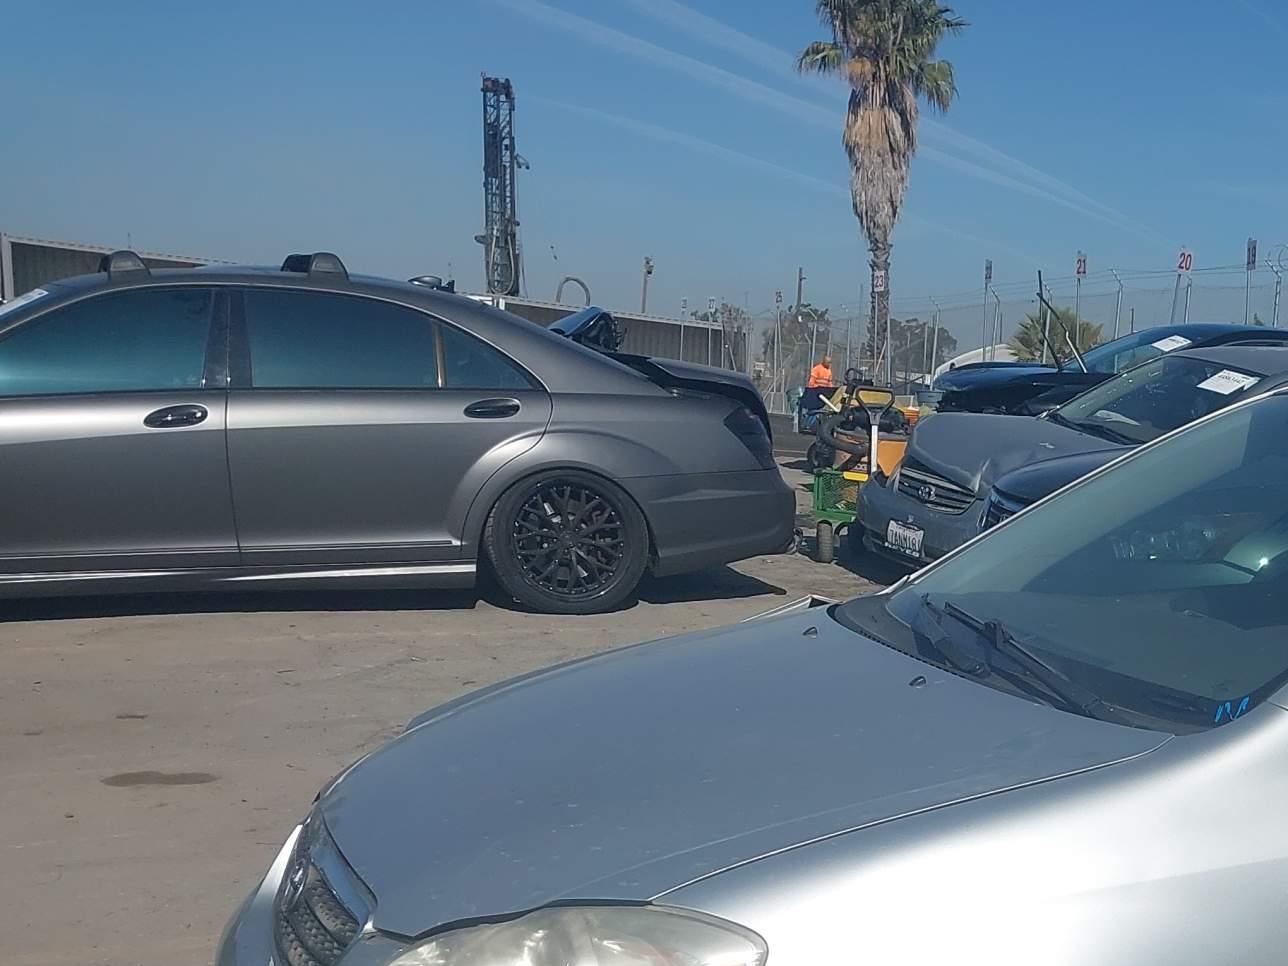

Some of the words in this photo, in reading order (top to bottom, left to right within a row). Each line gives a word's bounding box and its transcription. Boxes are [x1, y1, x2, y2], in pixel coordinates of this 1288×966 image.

[1178, 252, 1192, 271] 20
[1246, 247, 1257, 265] 19
[1076, 259, 1087, 275] 21
